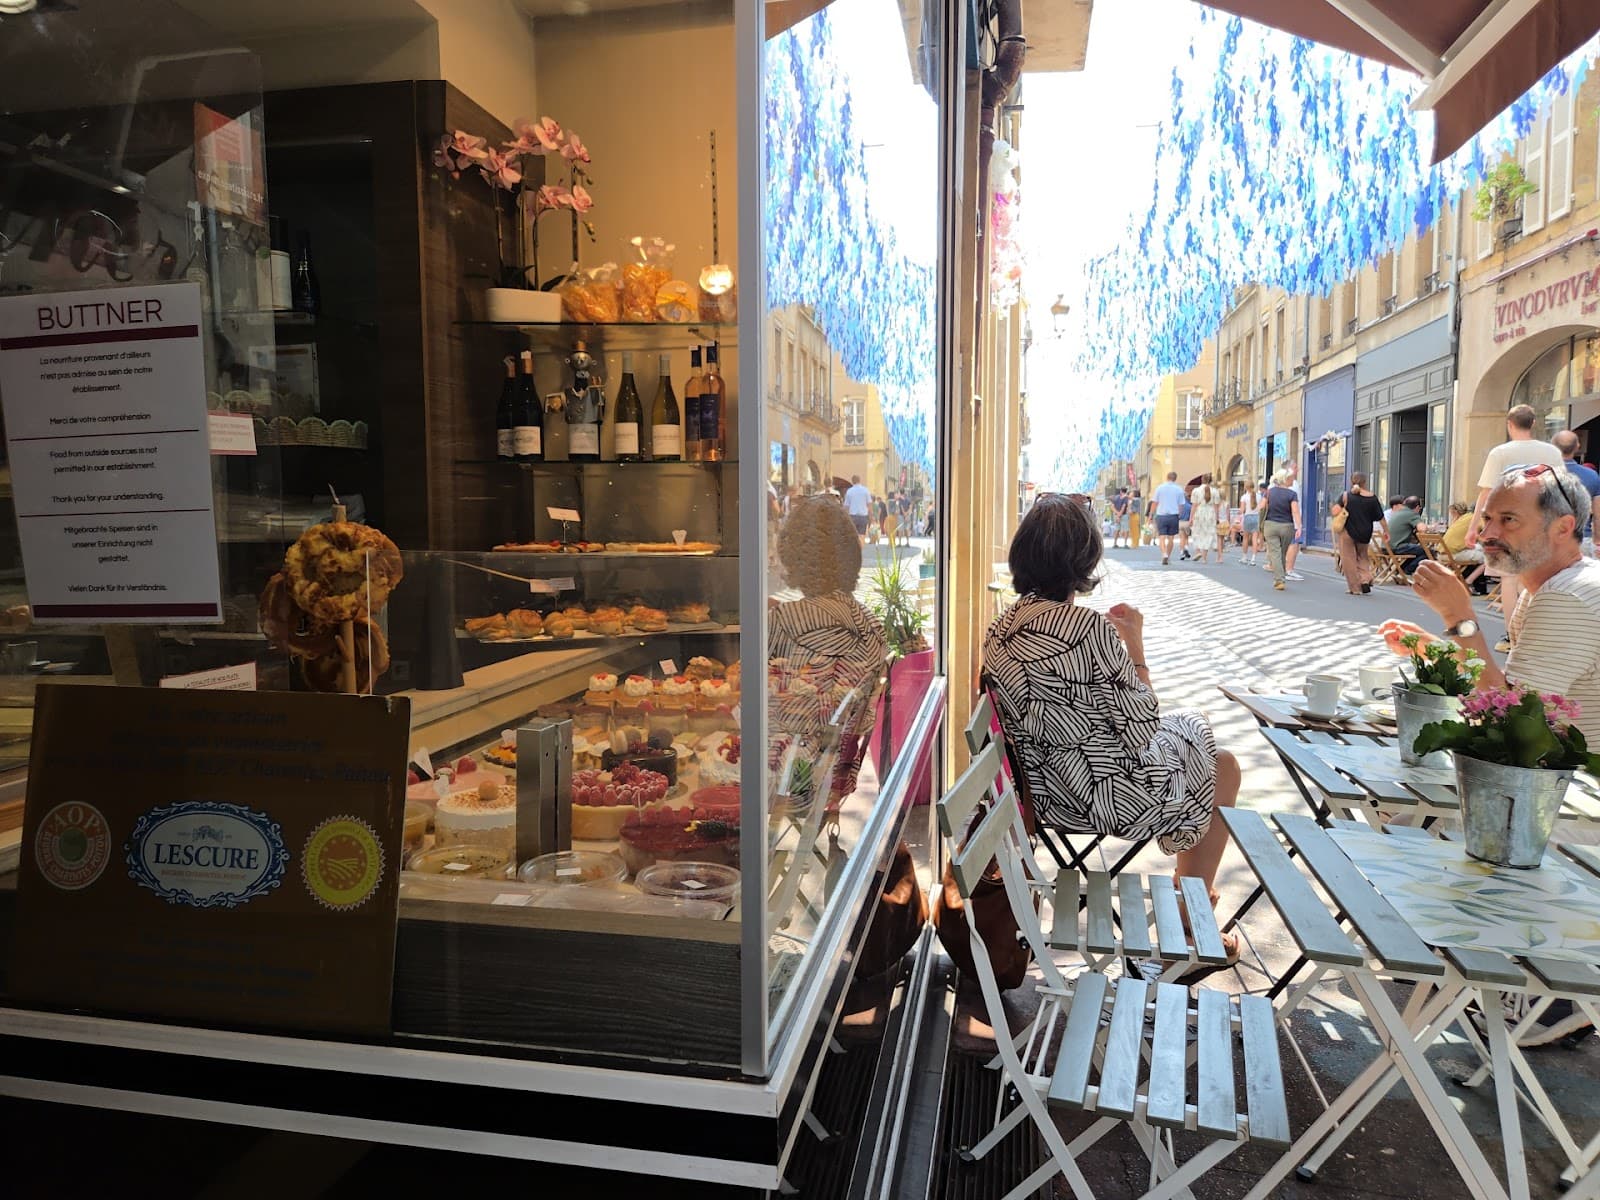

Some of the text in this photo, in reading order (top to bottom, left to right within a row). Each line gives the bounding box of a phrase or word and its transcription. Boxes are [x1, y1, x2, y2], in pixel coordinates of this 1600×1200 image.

[37, 299, 163, 330] BUTTNER
[50, 354, 82, 364] nourriture
[84, 352, 119, 363] provenant
[120, 351, 151, 360] d'ailleurs
[57, 372, 71, 381] pas
[72, 369, 97, 378] admise
[108, 367, 122, 376] sein
[124, 366, 132, 374] de
[134, 366, 152, 374] notre
[50, 413, 151, 425] Merci de votre compréhension
[50, 450, 68, 458] Food
[68, 449, 84, 458] from
[84, 448, 109, 457] outside
[145, 446, 158, 454] not
[54, 465, 86, 474] permitted
[52, 494, 73, 503] Thank
[74, 495, 86, 504] you
[86, 494, 96, 502] for
[96, 494, 112, 503] your
[64, 523, 158, 536] Mitgebrachte Speisen sind in
[72, 538, 153, 550] unserer Einrichtung nicht
[68, 584, 88, 592] Vielen
[88, 584, 105, 592] Dank
[106, 584, 116, 592] für
[53, 805, 100, 834] AOP
[152, 843, 260, 871] LESCURE
